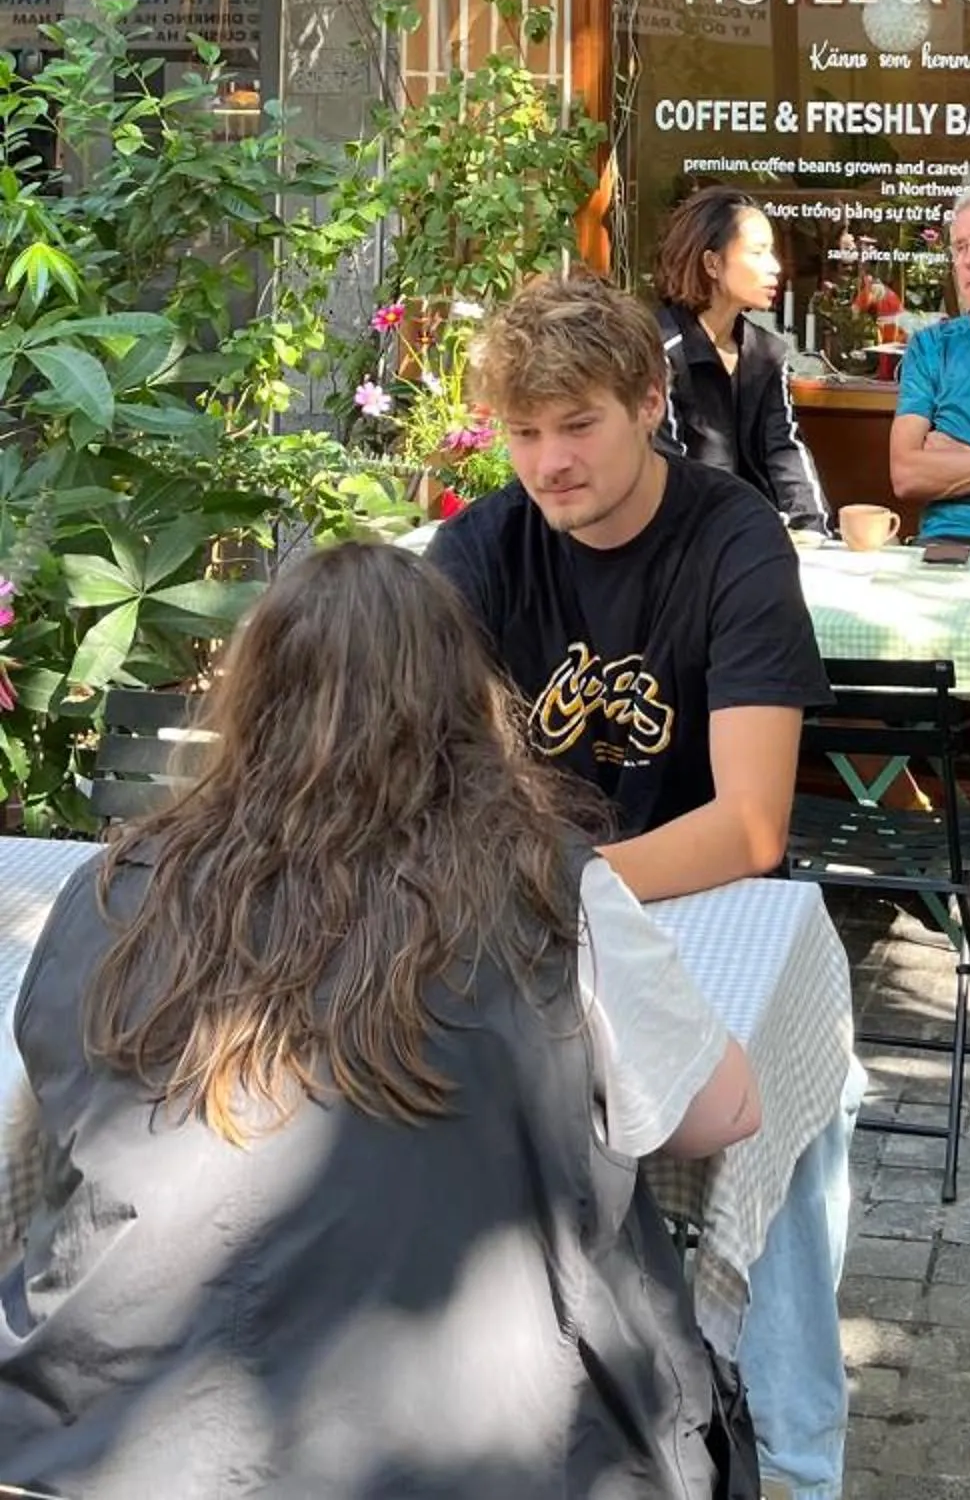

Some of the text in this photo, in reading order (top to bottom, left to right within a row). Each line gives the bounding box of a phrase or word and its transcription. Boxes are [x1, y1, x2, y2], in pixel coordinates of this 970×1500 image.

[809, 39, 868, 71] Känns
[655, 99, 767, 131] COFFEE
[774, 101, 799, 133] &
[806, 102, 938, 135] FRESHLY
[683, 156, 749, 175] premium
[751, 157, 795, 173] coffee
[798, 157, 842, 175] beans
[844, 162, 891, 177] grown
[895, 160, 924, 176] and
[927, 160, 970, 177] cared
[881, 180, 896, 195] in
[893, 249, 910, 261] for
